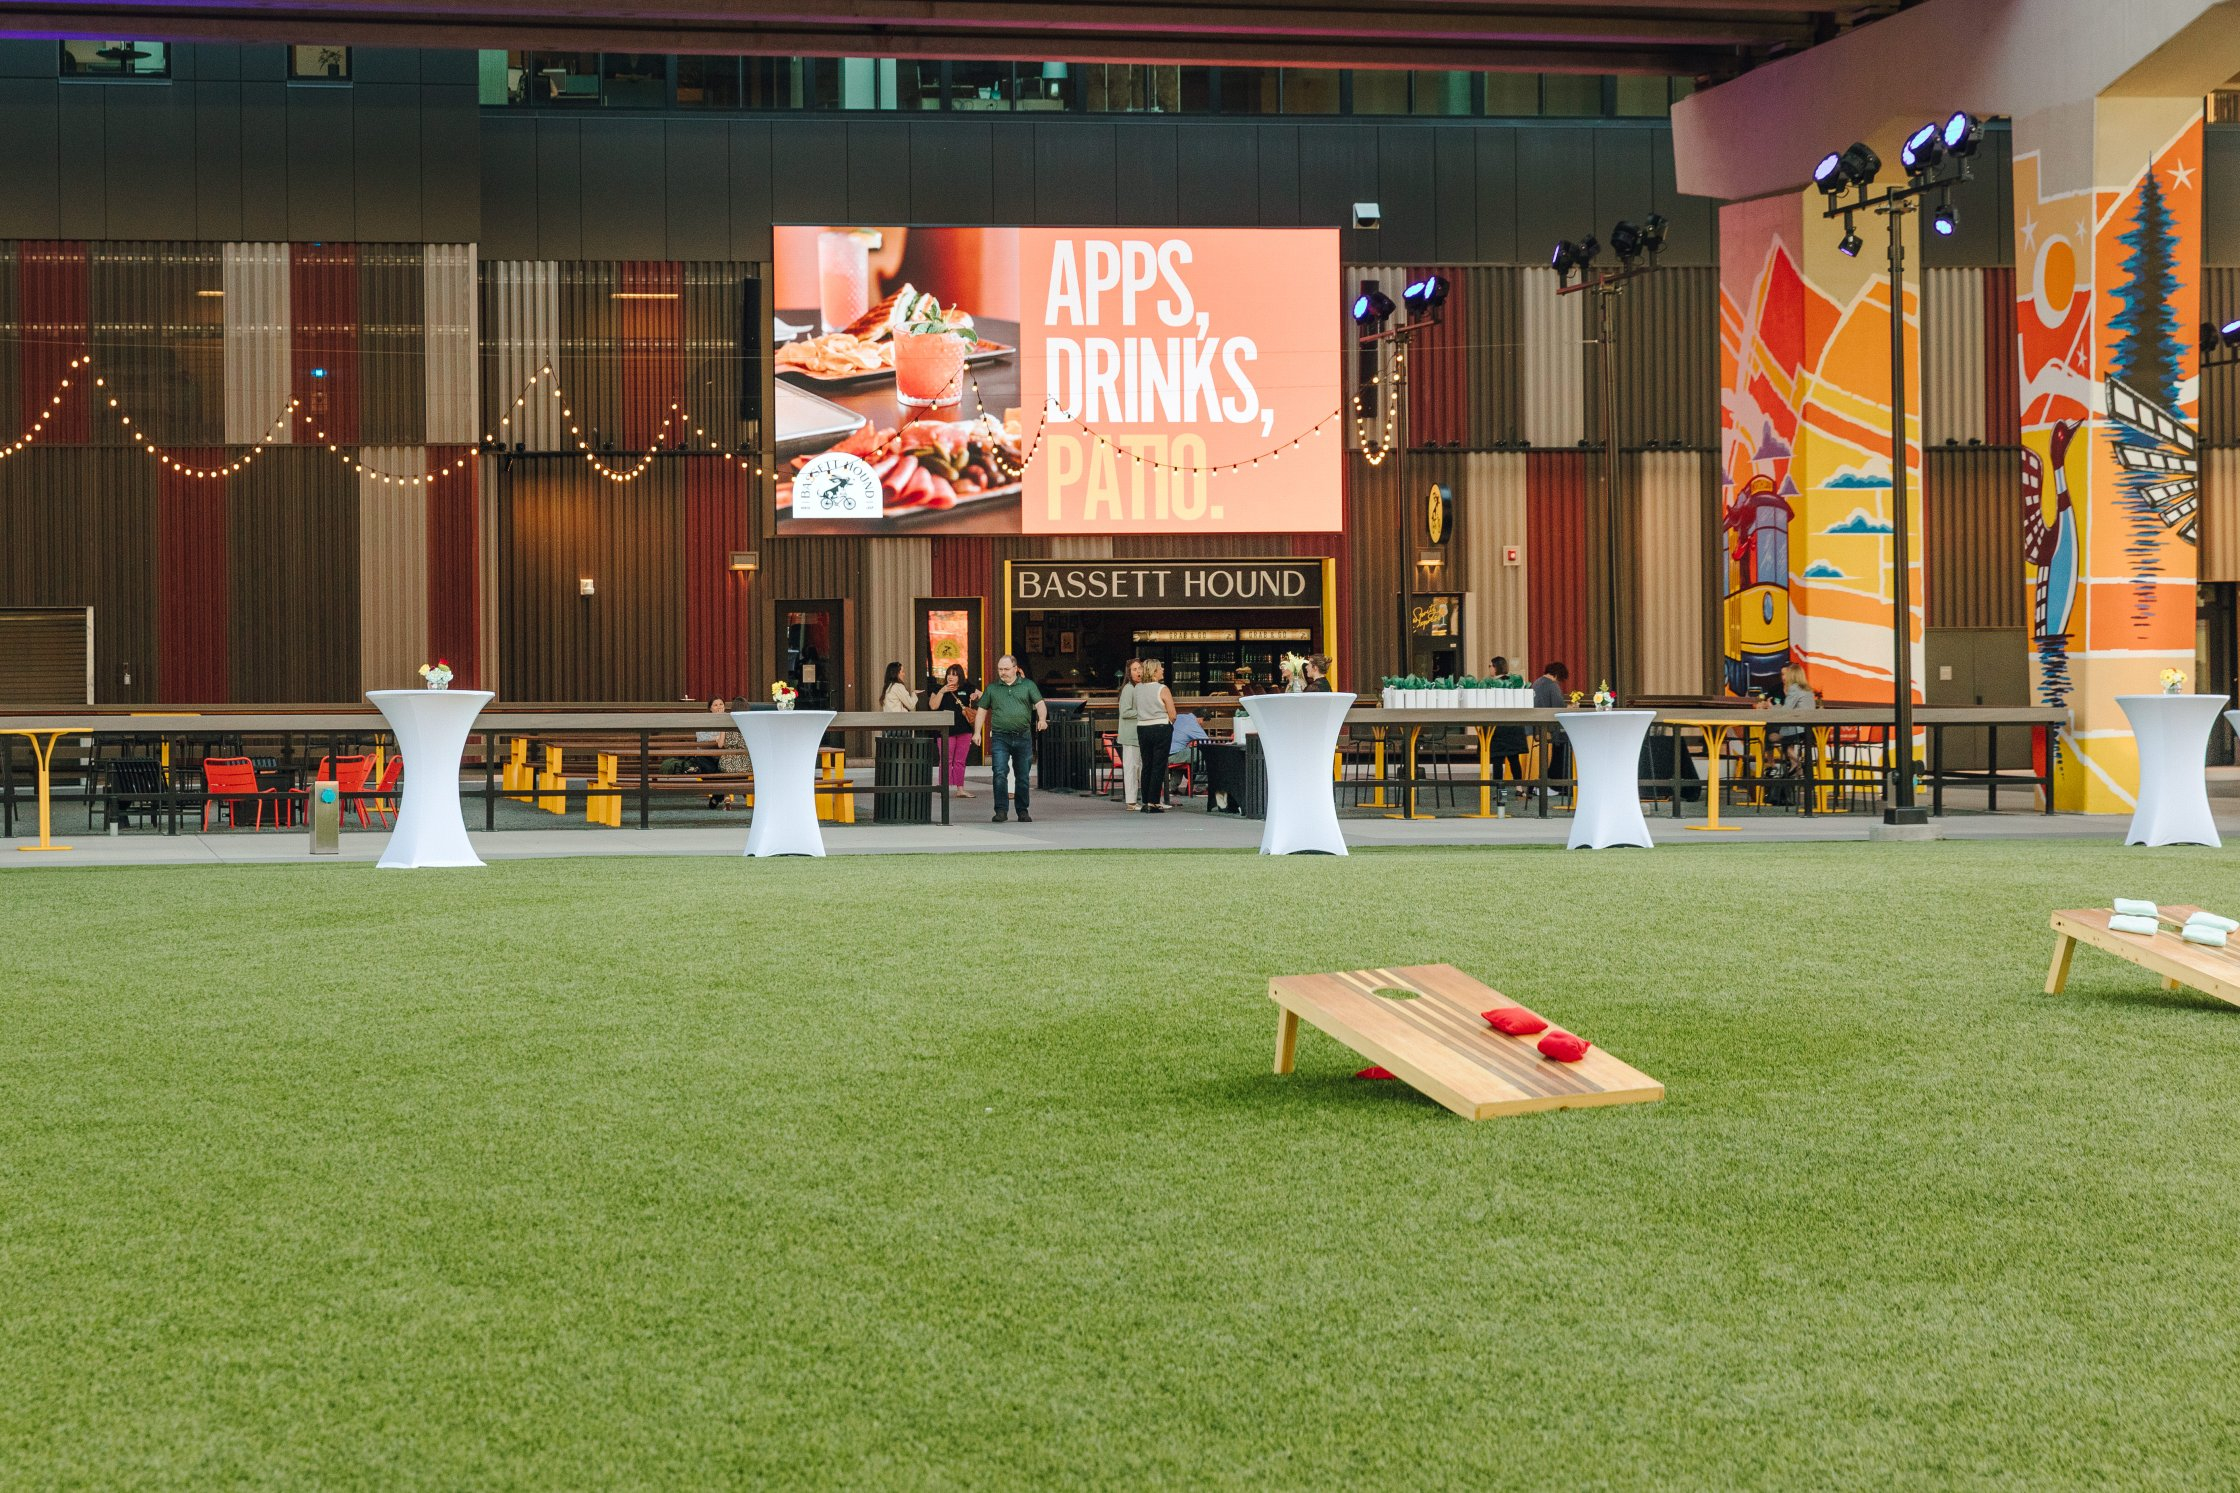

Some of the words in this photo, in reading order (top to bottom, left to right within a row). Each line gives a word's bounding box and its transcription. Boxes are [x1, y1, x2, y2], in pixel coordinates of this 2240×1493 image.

[1045, 239, 1209, 341] APPS,
[1046, 336, 1274, 437] DRINKS,
[1047, 433, 1224, 520] PATIO.
[1019, 570, 1171, 598] BASSETT
[1184, 570, 1306, 598] HOUND
